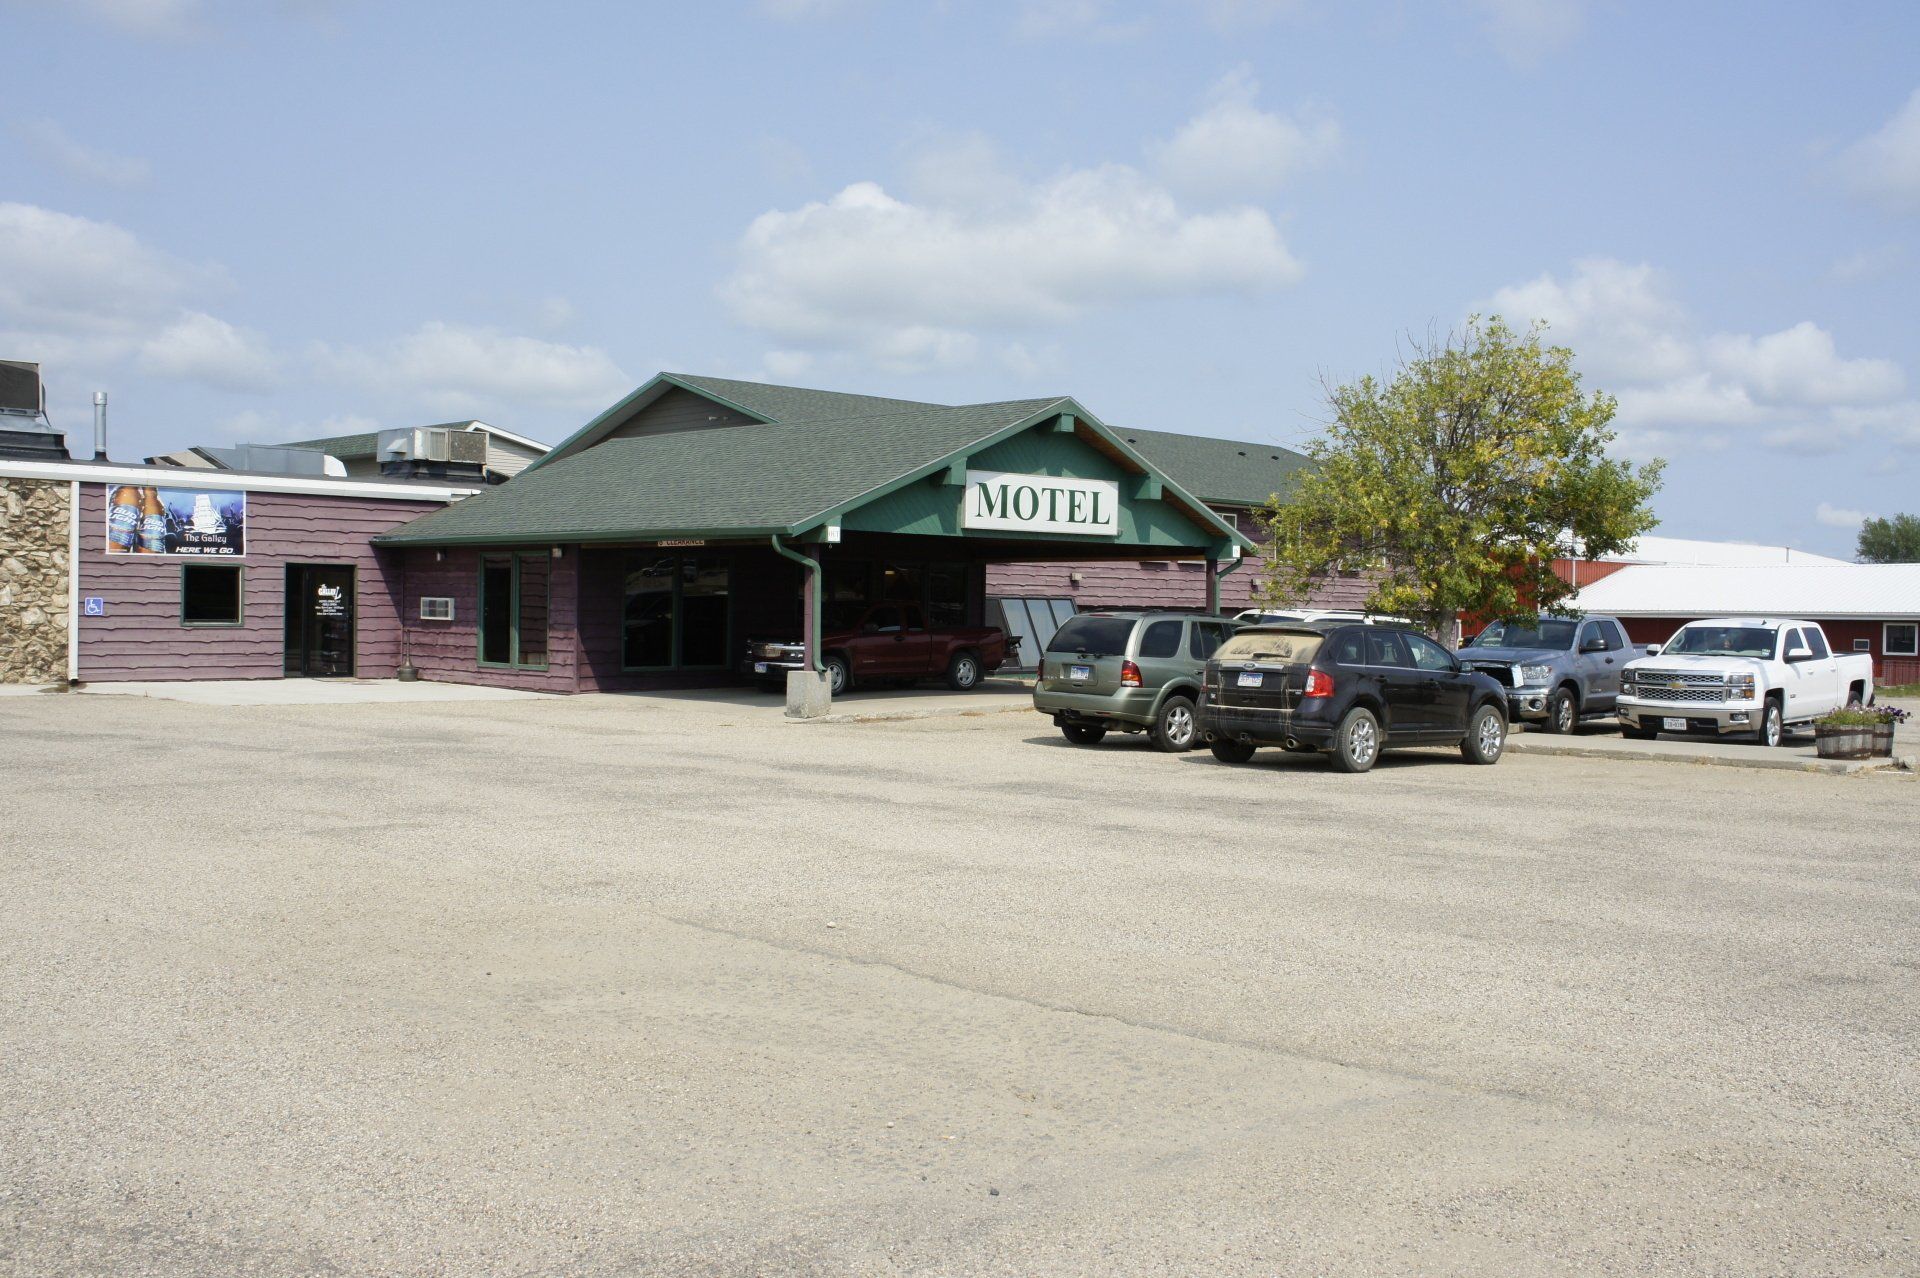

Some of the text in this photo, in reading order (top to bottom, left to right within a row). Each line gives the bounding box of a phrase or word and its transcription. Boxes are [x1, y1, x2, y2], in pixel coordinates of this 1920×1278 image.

[975, 482, 1111, 525] MOTEL
[113, 507, 137, 519] BUD
[143, 517, 163, 527] BUD
[184, 533, 227, 545] The Galley
[175, 546, 202, 554] HERE
